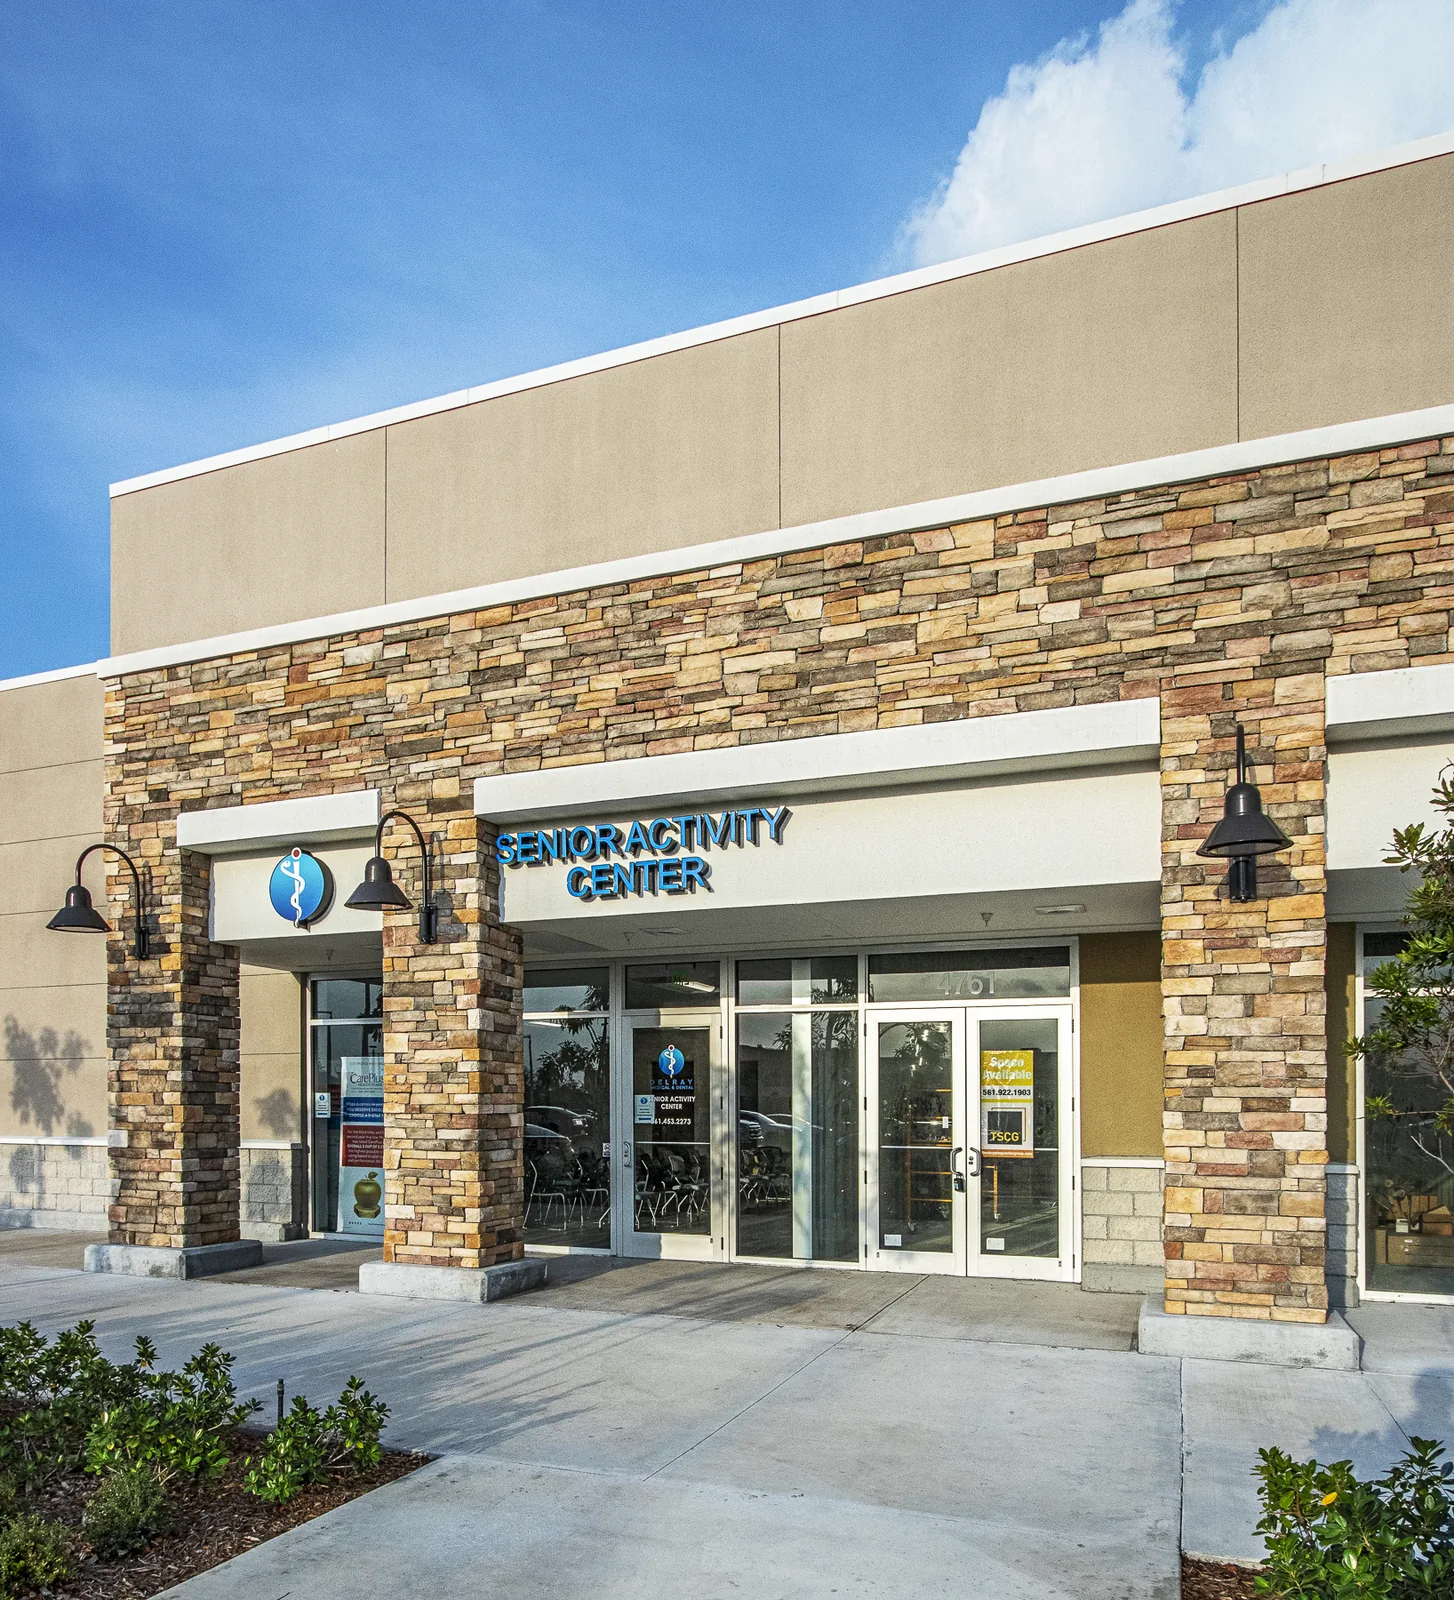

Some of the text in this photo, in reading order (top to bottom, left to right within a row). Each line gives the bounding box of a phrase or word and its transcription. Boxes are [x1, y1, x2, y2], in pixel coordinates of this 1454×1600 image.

[496, 806, 787, 864] SENIOR ACTIVITY
[567, 856, 706, 897] CENTER
[936, 971, 995, 995] 4761
[990, 1056, 1024, 1069] Space
[983, 1069, 1032, 1080] Available
[990, 1131, 1019, 1142] TSCG
